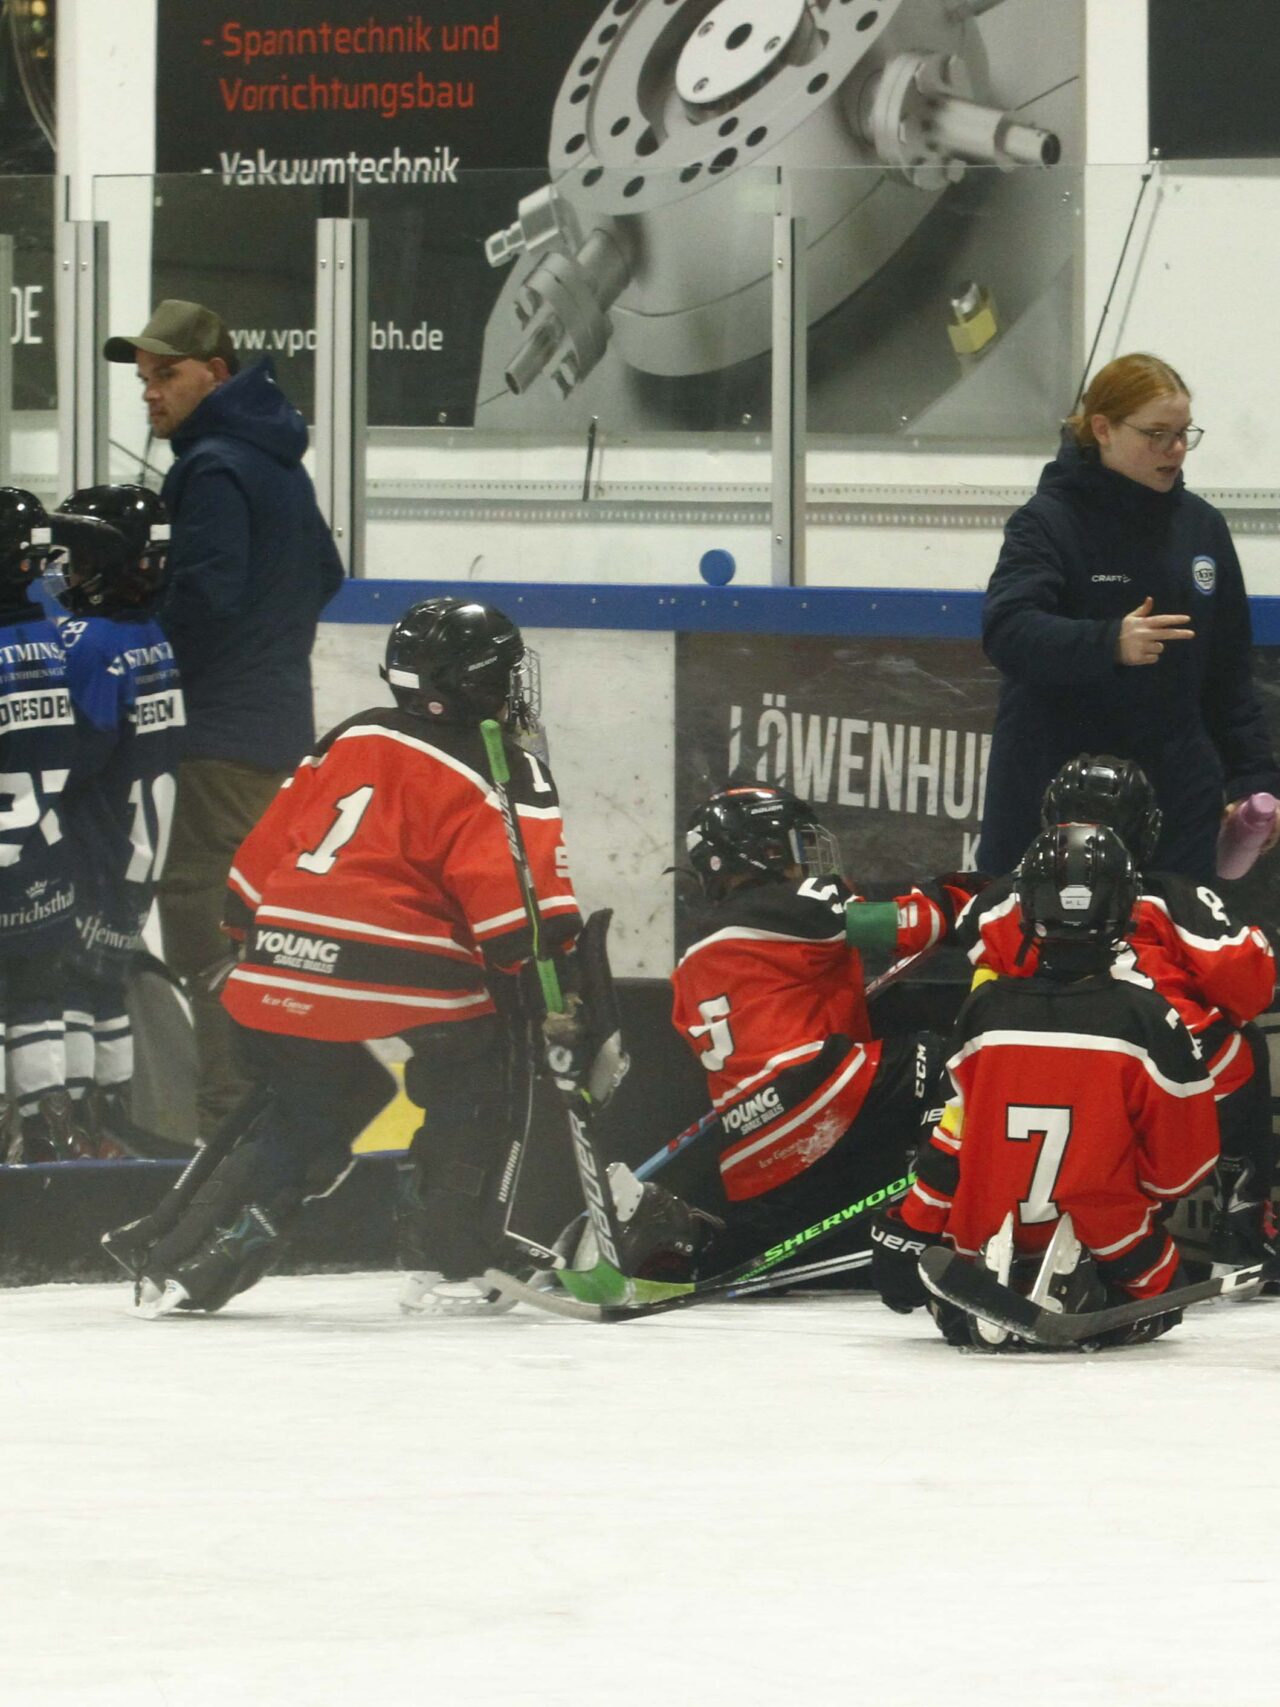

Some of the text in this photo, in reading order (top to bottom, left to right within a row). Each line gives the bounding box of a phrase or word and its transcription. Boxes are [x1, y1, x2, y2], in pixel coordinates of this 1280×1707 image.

[222, 16, 432, 64] Spanntechnik
[442, 16, 499, 51] und
[219, 72, 475, 118] Vorrichtungsbau
[219, 147, 460, 186] Vakuumtechnik
[1091, 574, 1122, 583] CRAFT
[525, 751, 552, 793] 1
[296, 784, 374, 876] 1
[255, 930, 341, 963] YOUNG
[915, 1042, 927, 1098] CCM
[721, 1086, 780, 1134] YOUNG
[1006, 1103, 1074, 1227] 7
